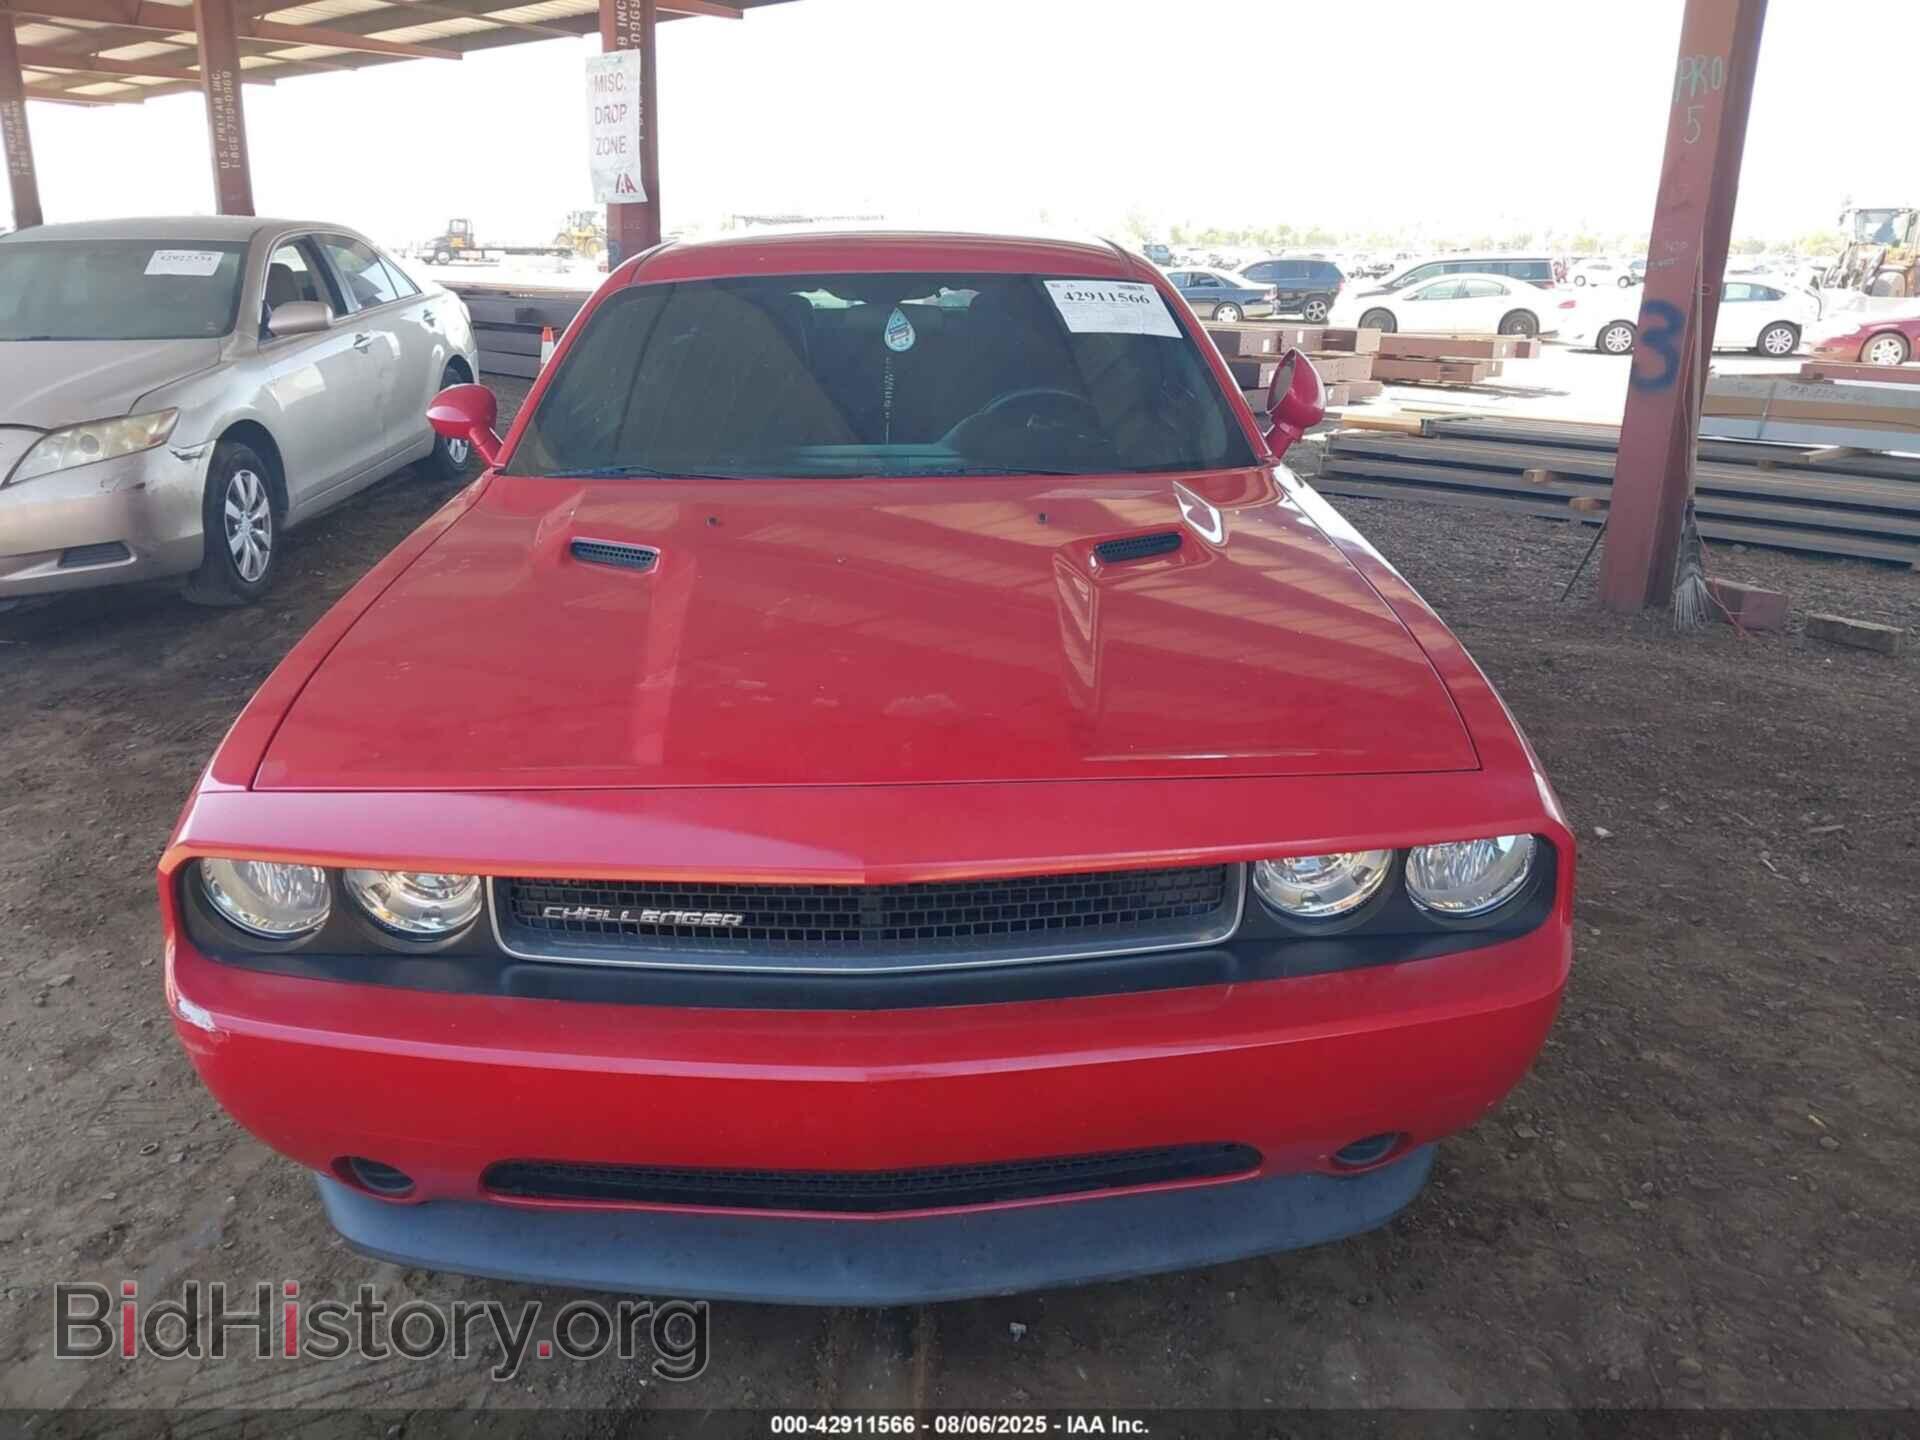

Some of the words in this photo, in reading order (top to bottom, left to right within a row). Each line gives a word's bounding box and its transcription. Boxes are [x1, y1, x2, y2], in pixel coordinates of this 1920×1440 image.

[594, 72, 627, 93] MISC.
[594, 103, 628, 125] DROP
[1683, 105, 1705, 144] 5
[594, 136, 627, 156] ZONE
[1064, 291, 1151, 305] 42911566
[1630, 301, 1686, 392] 3
[542, 905, 744, 927] CHALLENGER
